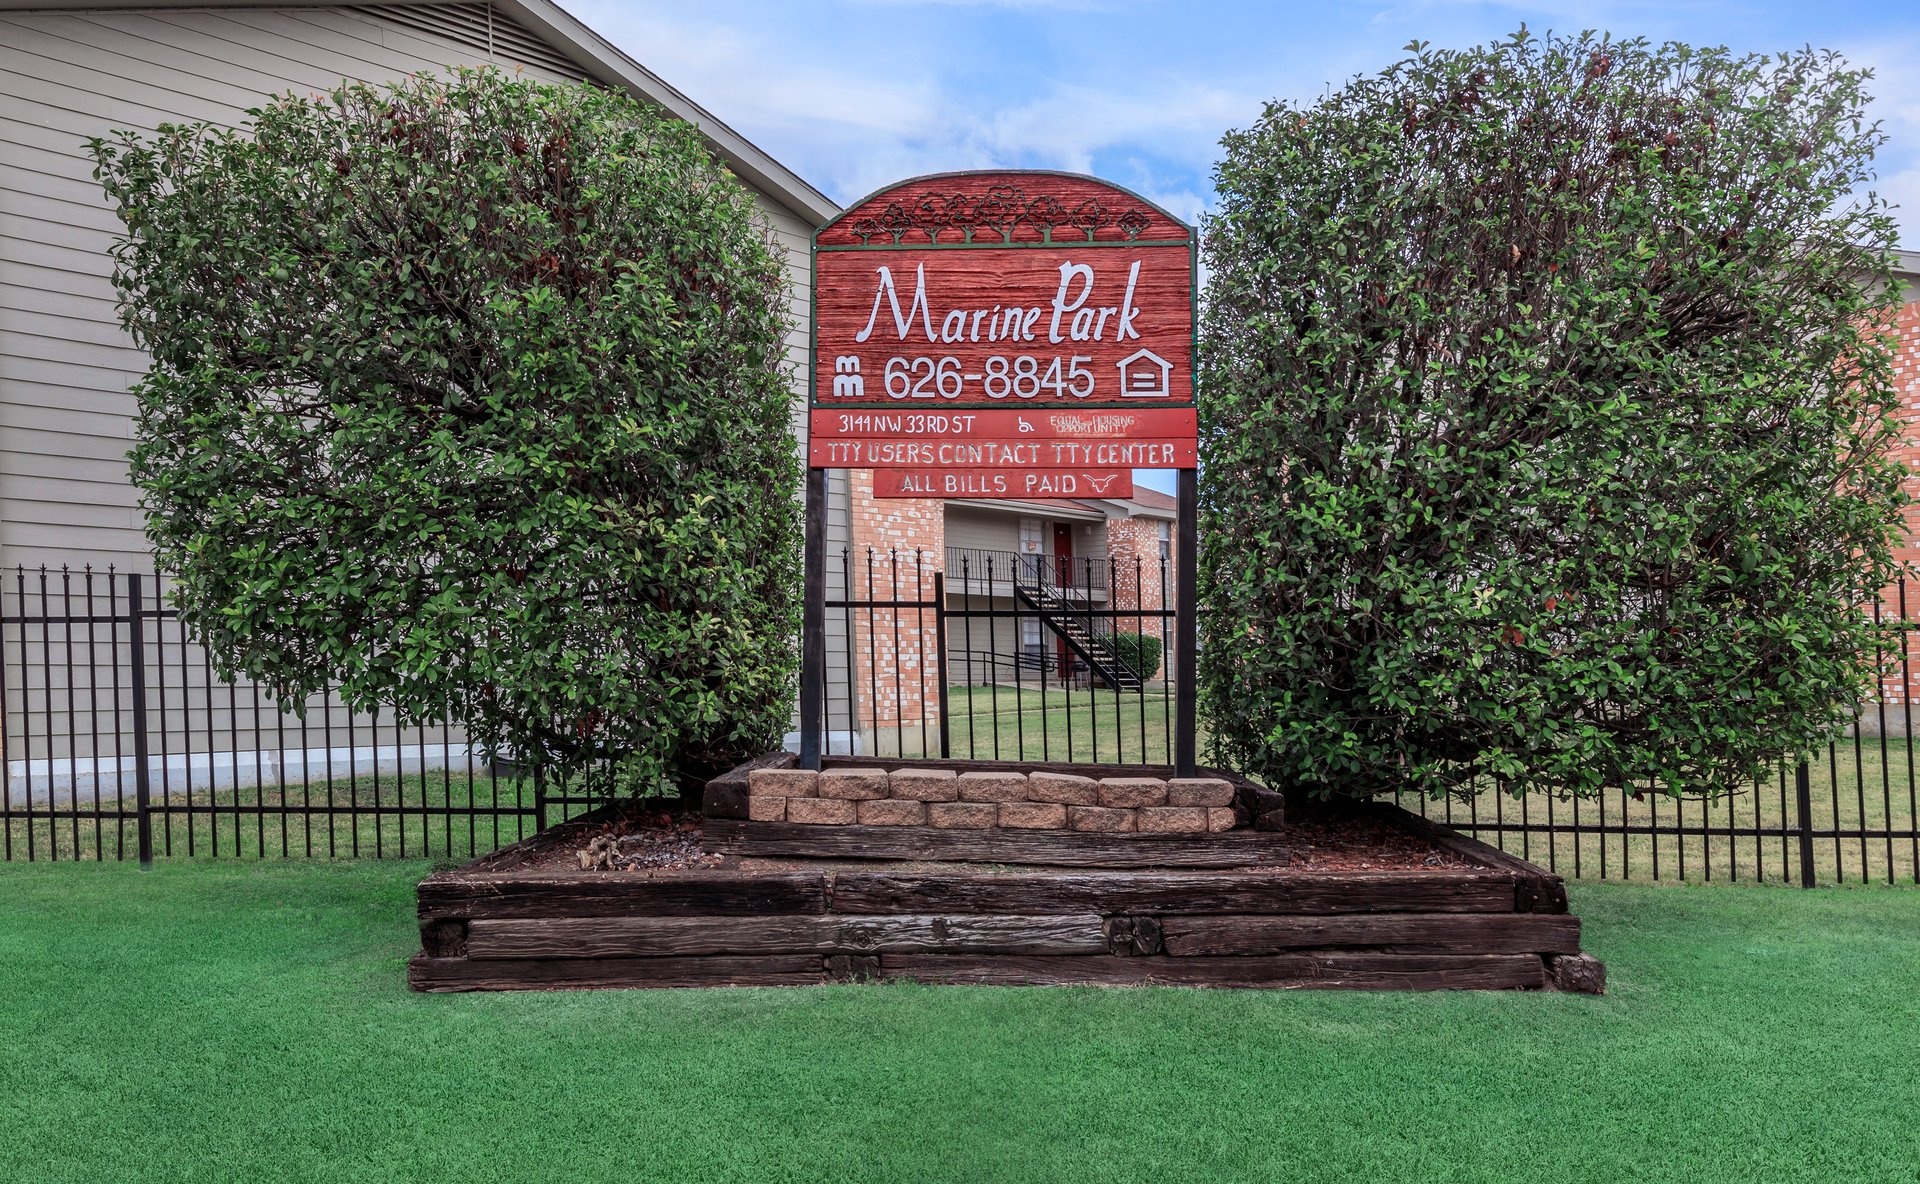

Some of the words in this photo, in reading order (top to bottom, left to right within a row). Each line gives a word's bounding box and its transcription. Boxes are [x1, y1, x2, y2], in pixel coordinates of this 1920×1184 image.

[855, 261, 1042, 344] Marine
[1048, 259, 1142, 344] Park
[884, 354, 1095, 399] 626-8845
[838, 415, 871, 433] 3144
[874, 415, 901, 433] NW
[905, 416, 949, 433] 33RD
[951, 415, 977, 433] ST
[1050, 415, 1082, 427] EQUAL
[1092, 415, 1135, 426] HOUSING
[1055, 423, 1128, 434] OPPORTUNITY
[828, 441, 863, 462] TTY
[868, 442, 935, 464] USERS
[938, 443, 1041, 464] CONTACT
[1051, 443, 1092, 464] TTY
[1096, 443, 1175, 464] CENTER
[901, 475, 937, 493] ALL
[944, 475, 1007, 493] BILLS
[1025, 474, 1077, 494] PAID
